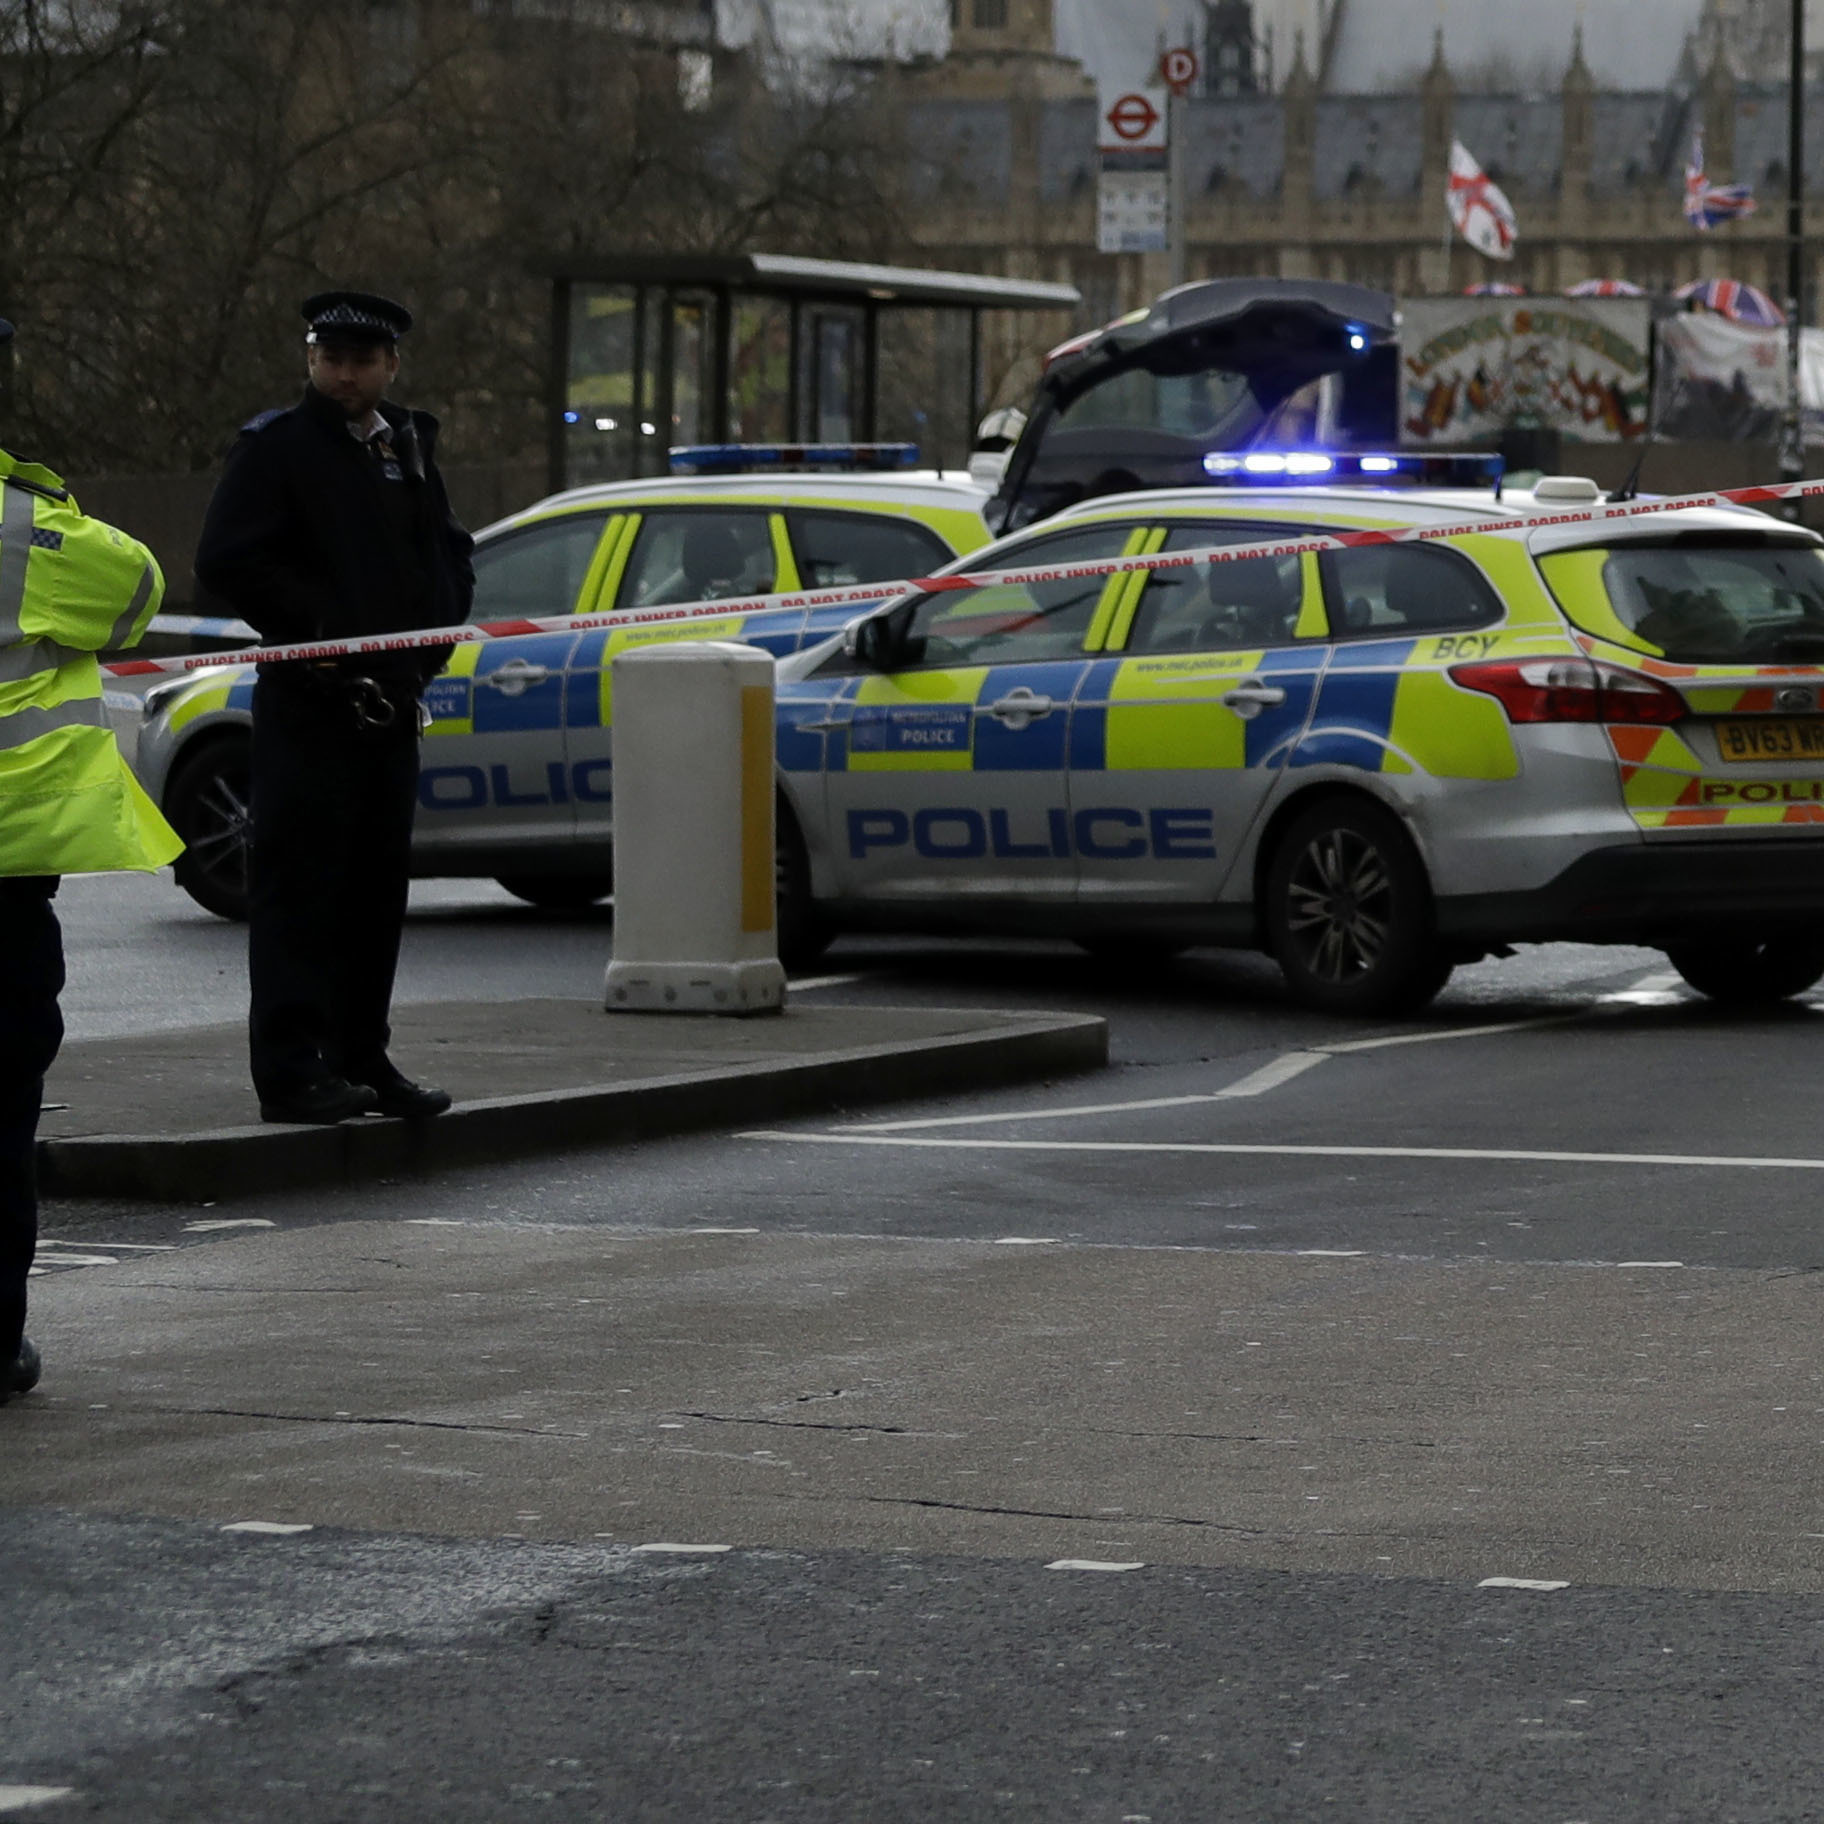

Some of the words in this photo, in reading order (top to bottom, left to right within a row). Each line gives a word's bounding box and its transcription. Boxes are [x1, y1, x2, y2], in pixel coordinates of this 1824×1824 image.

[1432, 635, 1500, 660] BCY
[901, 728, 956, 744] POLICE
[1729, 727, 1793, 754] BV63
[417, 758, 614, 811] OLIC
[846, 807, 1218, 860] POLICE
